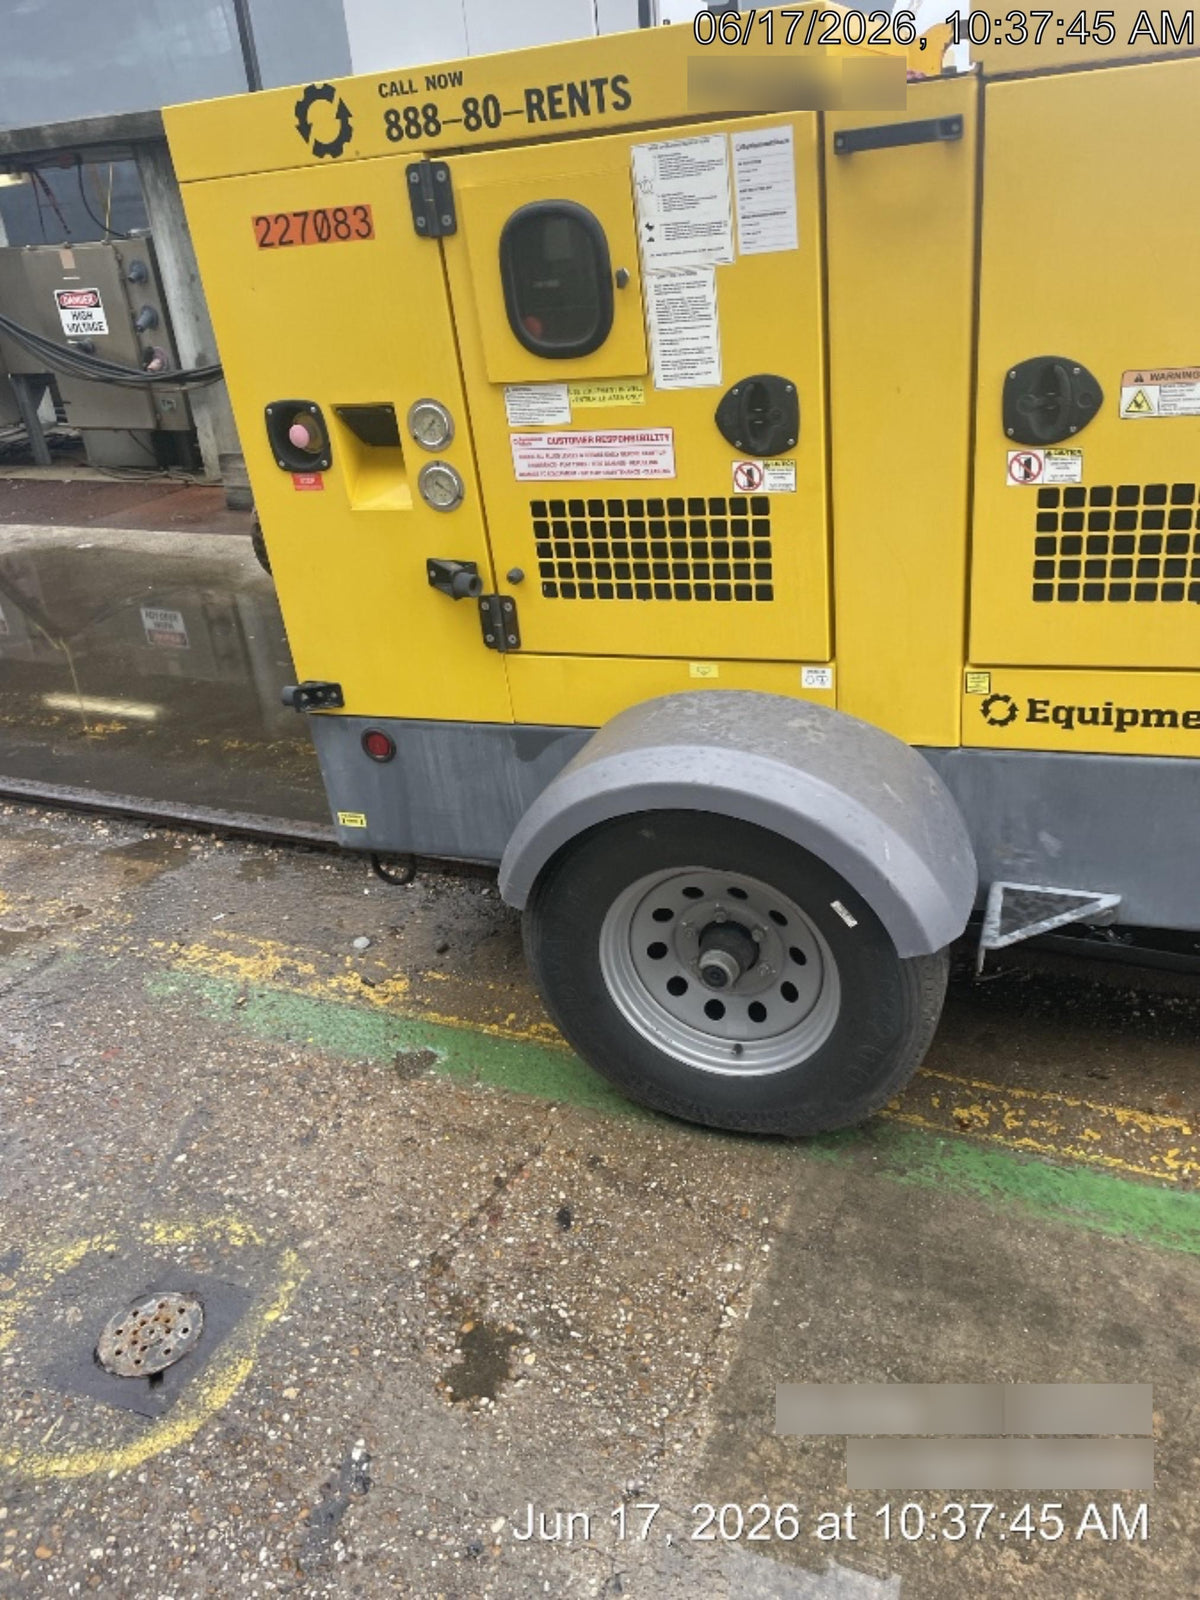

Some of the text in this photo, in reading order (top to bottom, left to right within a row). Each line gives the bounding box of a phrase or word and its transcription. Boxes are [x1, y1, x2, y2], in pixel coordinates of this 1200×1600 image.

[378, 71, 463, 98] CALL NOW
[255, 205, 371, 248] 227083
[1026, 698, 1200, 733] Equipme
